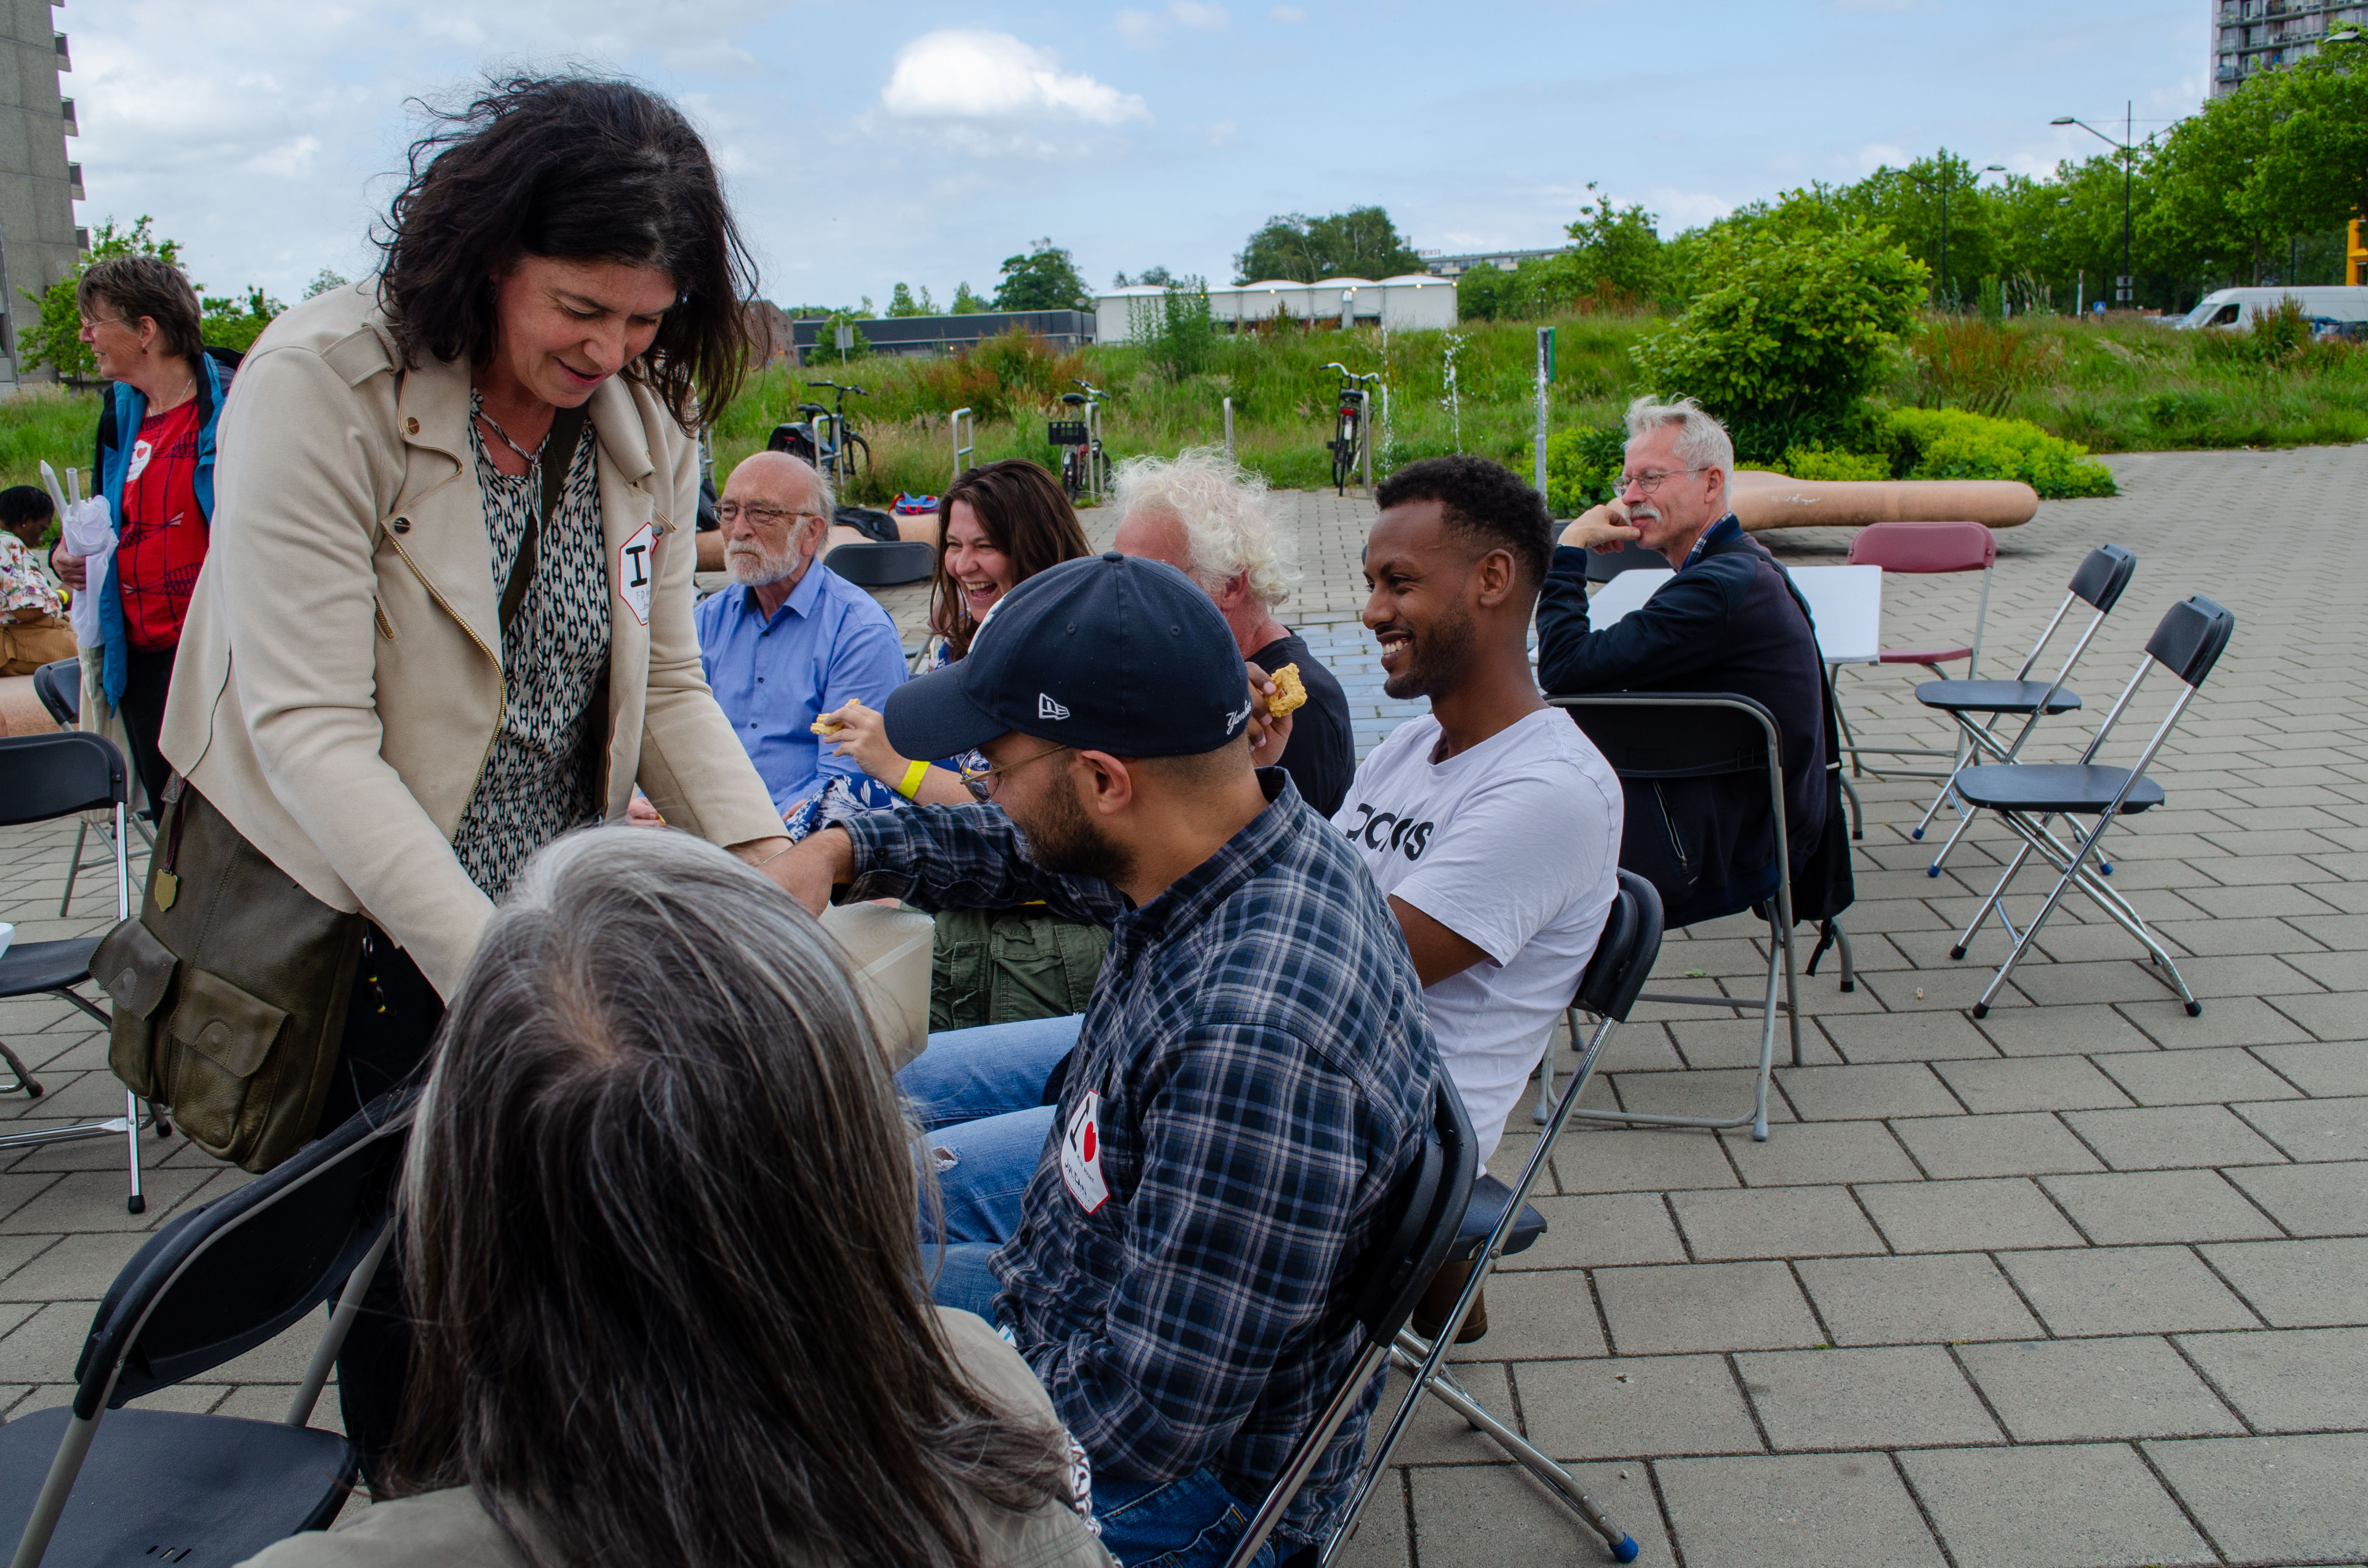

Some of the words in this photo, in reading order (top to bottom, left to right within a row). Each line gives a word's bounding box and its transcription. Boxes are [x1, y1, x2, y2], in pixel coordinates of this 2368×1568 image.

[626, 545, 647, 588] I
[1345, 803, 1433, 861] ads
[1070, 1096, 1089, 1152] I
